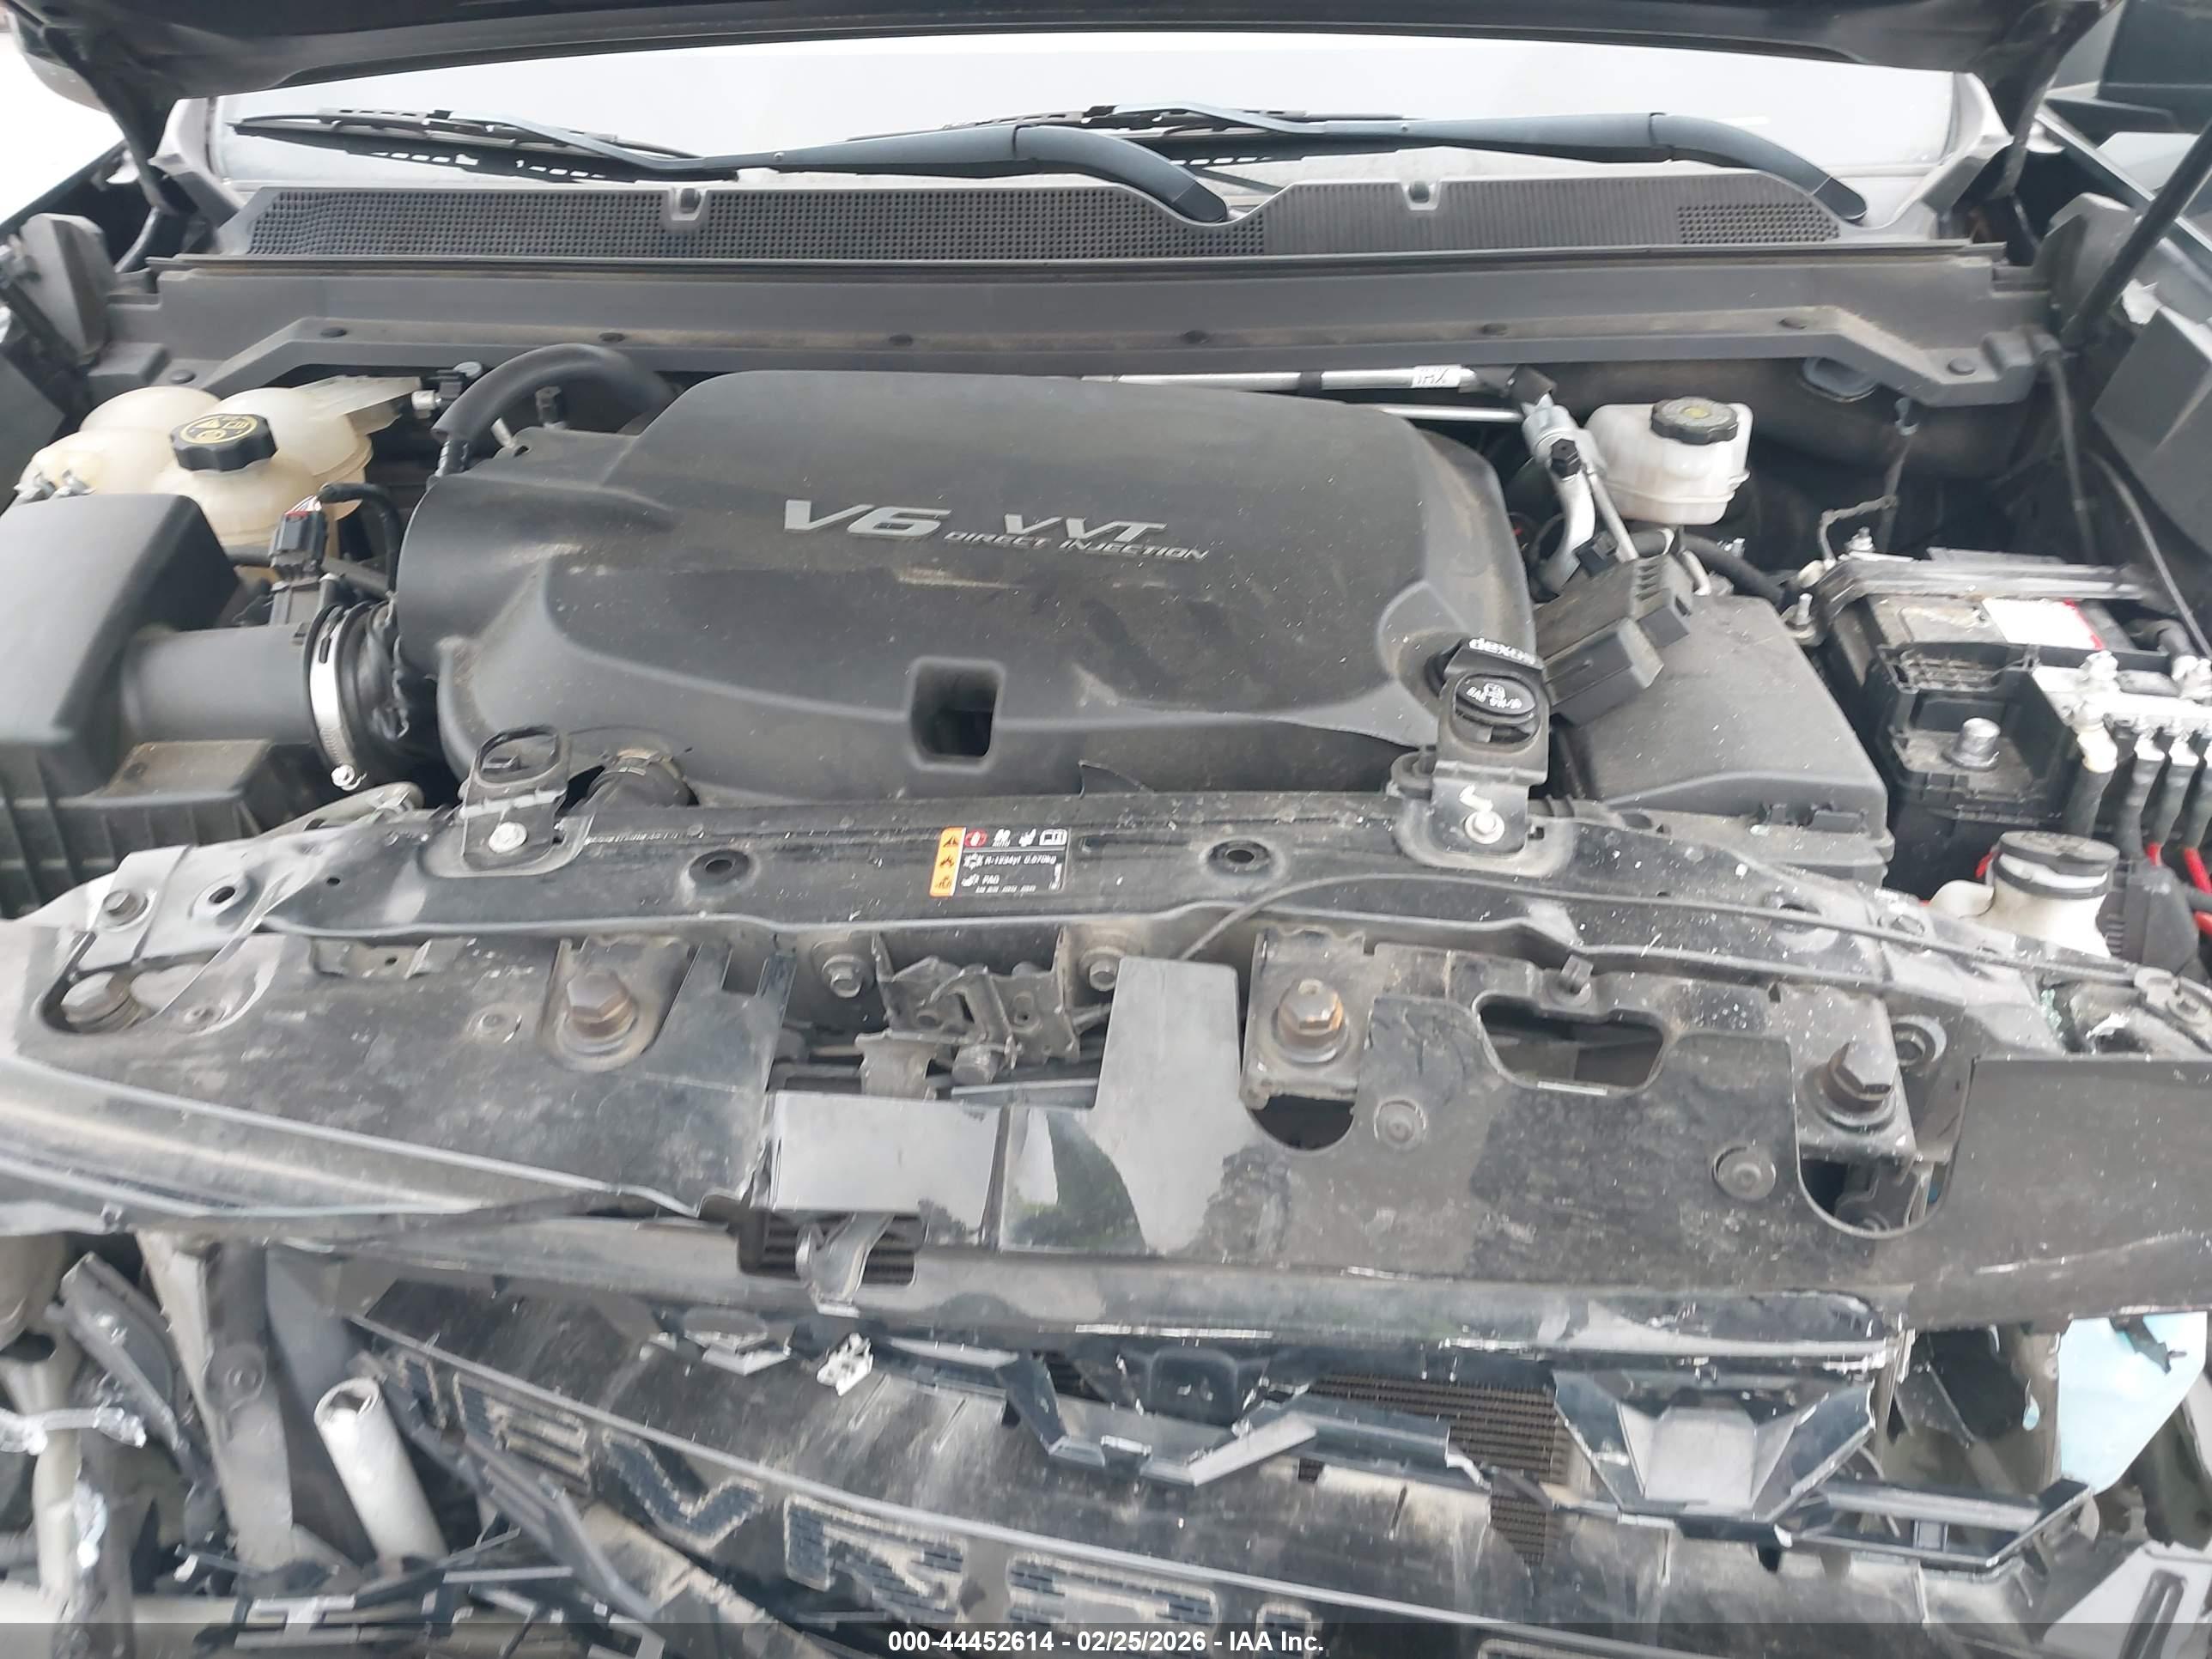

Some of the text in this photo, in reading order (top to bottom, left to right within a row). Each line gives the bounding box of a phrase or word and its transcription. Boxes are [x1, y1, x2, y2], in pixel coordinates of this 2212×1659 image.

[784, 499, 1168, 543] V6 VVT
[945, 531, 1209, 560] DIRECT INJECTION
